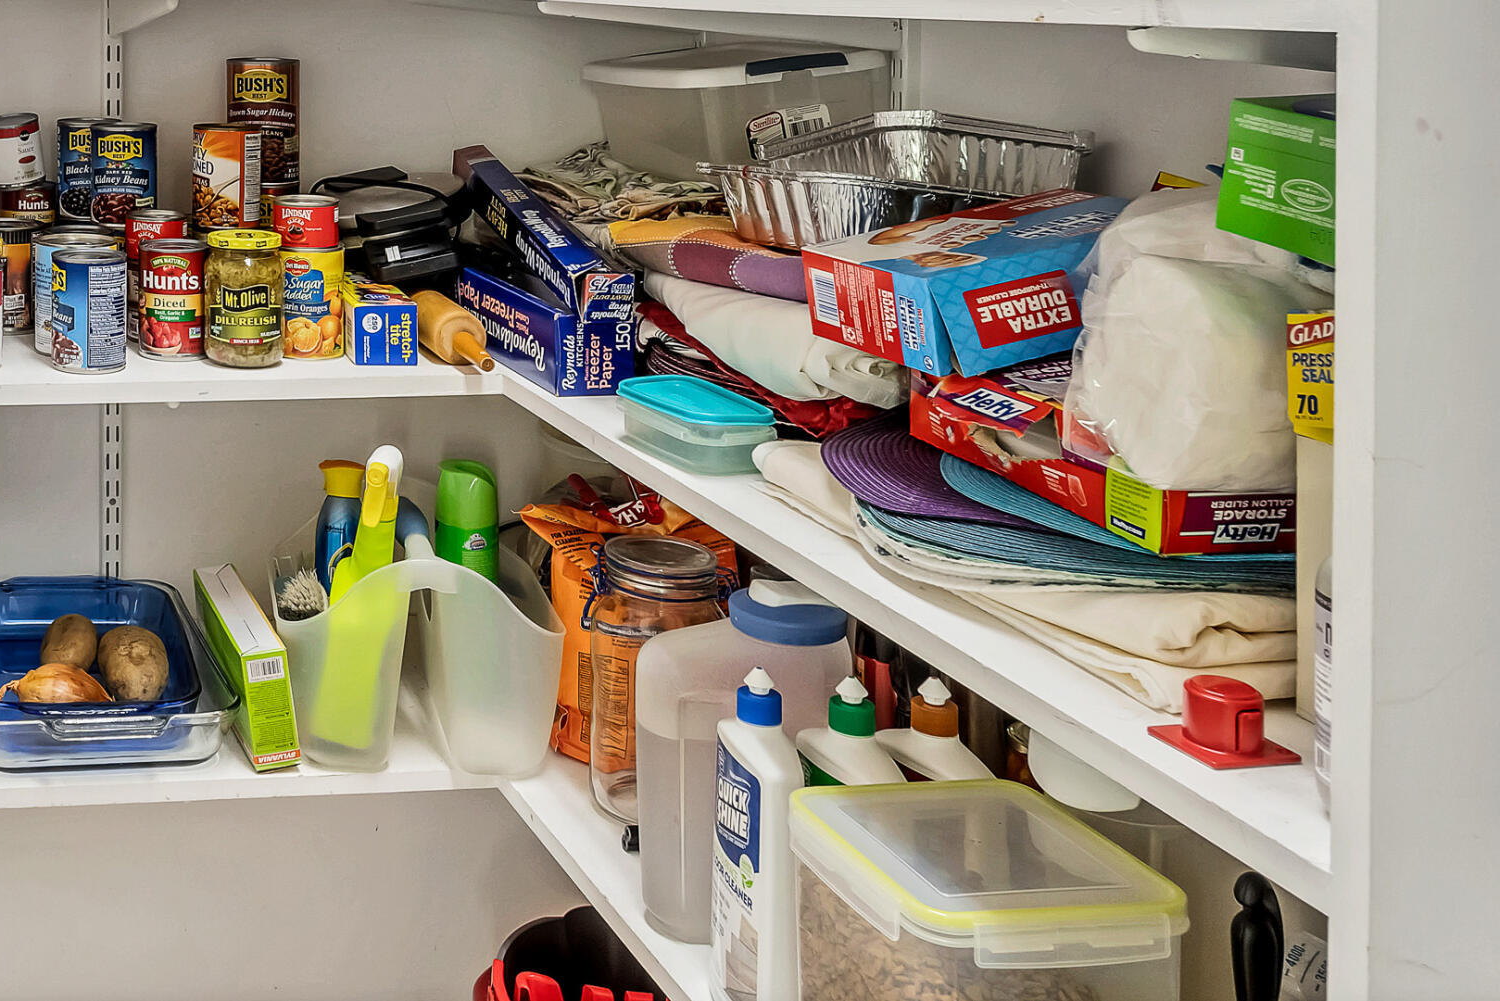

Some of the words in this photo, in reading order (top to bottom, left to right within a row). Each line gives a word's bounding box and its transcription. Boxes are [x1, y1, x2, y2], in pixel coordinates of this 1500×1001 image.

[236, 76, 285, 94] BUSH'S
[246, 107, 268, 117] Sugar
[268, 108, 295, 119] Hickory
[752, 116, 780, 130] Sterilite
[99, 138, 141, 155] BUSH'S
[66, 165, 89, 175] Black
[94, 174, 121, 186] Kidney
[122, 174, 148, 186] Beans
[18, 199, 49, 210] Hunt's
[281, 207, 313, 219] LINDSAY
[132, 221, 163, 235] LINDSAY
[515, 230, 535, 269] Wrap
[142, 269, 199, 291] Hunt's
[288, 279, 324, 292] Sugar
[534, 260, 571, 309] Reynolds
[589, 275, 610, 293] 75
[153, 297, 186, 308] Diced
[224, 295, 241, 309] Mt.
[241, 290, 266, 308] Olive
[284, 289, 312, 301] Added
[976, 289, 1009, 304] CLEANER
[299, 304, 328, 315] Oranges
[480, 289, 515, 329] Freezer
[590, 310, 629, 321] Reynolds
[608, 302, 632, 312] Wrap
[976, 289, 1068, 324] DURABLE
[215, 315, 236, 326] DILL
[237, 314, 277, 326] RELISH
[881, 289, 894, 343] DURABLE
[898, 294, 912, 350] Eraser
[907, 298, 920, 351] Magic
[1007, 305, 1073, 334] EXTRA
[390, 324, 400, 345] tite
[400, 313, 414, 364] stretch-
[616, 323, 632, 352] 150
[1289, 321, 1334, 345] GLAD
[500, 326, 546, 373] Reynolds
[576, 320, 584, 368] KITCHENS
[562, 334, 575, 391] Reynolds
[587, 333, 601, 390] Freezer
[600, 345, 613, 390] Paper
[1301, 368, 1334, 384] SEAL
[962, 388, 1024, 420] Hefty
[1296, 393, 1319, 415] 70
[1210, 500, 1250, 509] SLIDER
[1251, 499, 1294, 507] GALLON
[1213, 508, 1288, 521] STORAGE
[1216, 525, 1278, 541] Hefty
[257, 750, 297, 764] SYLVANIA
[718, 776, 748, 813] QUICK
[716, 800, 749, 839] SHINE
[724, 871, 754, 912] CLEANER
